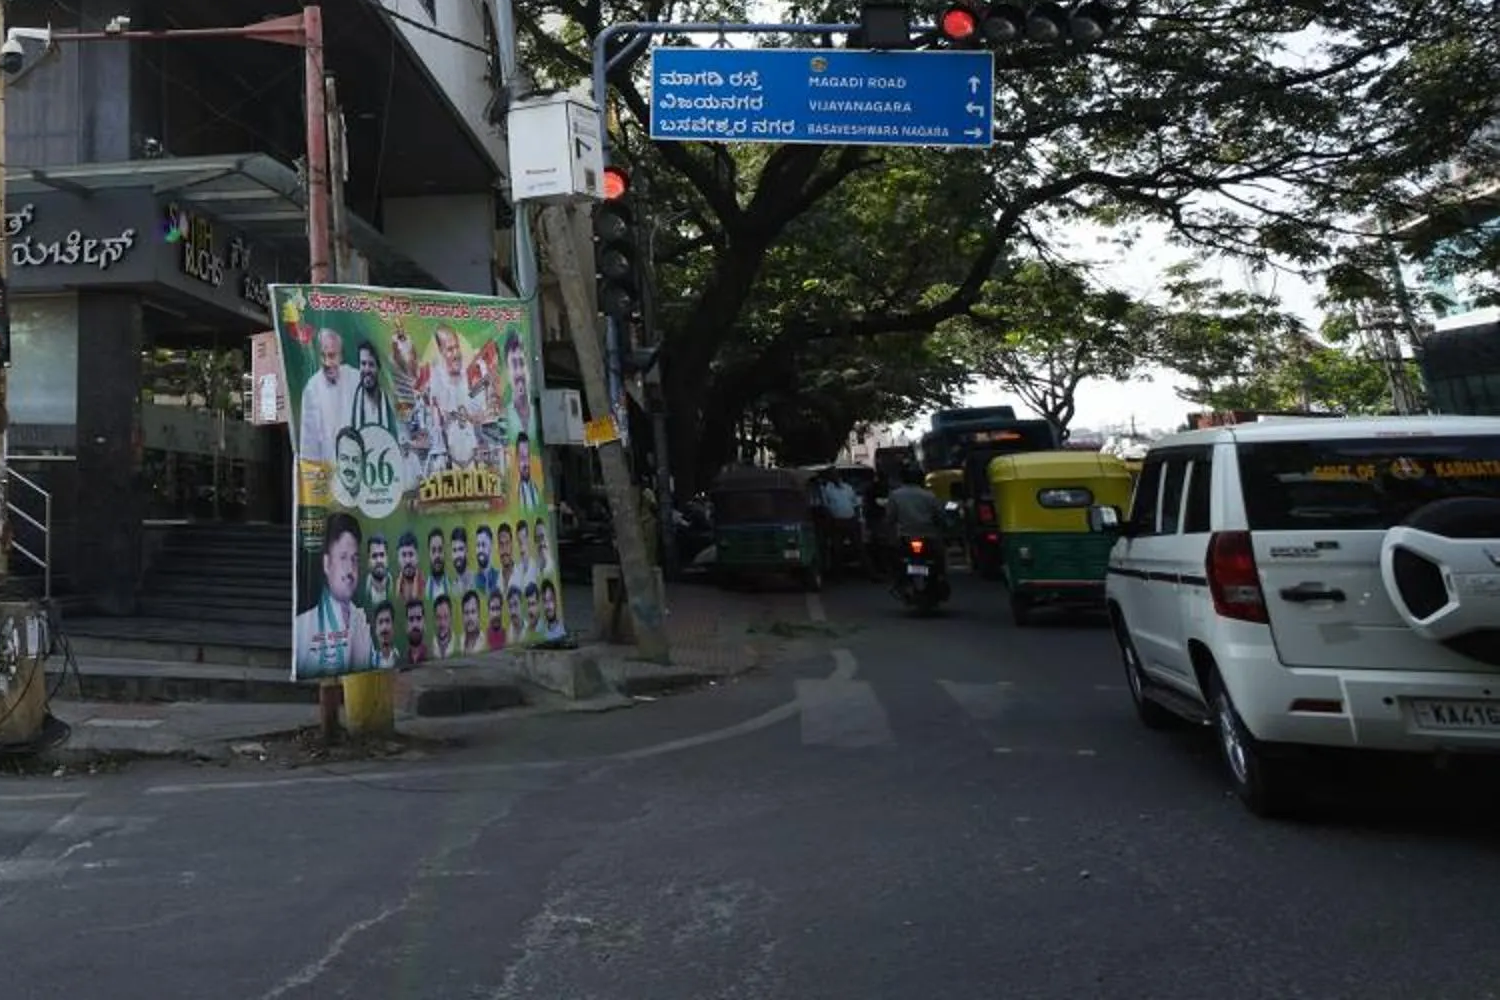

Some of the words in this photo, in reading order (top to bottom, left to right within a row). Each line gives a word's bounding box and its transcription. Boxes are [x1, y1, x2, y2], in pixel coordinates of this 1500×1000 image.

[659, 70, 724, 86] ಮಾಗಡಿ
[729, 70, 763, 91] ರಸ್ತೆ
[808, 76, 863, 88] MAGADI
[867, 77, 907, 89] ROAD
[659, 92, 764, 110] ವಿಜಯನಗರ
[808, 100, 912, 113] VIJAYANAGARA
[660, 116, 747, 136] ಬಸವೇಶ್ವರ
[751, 119, 795, 134] ನಗರ
[807, 123, 899, 136] BASAVESHWARA
[901, 126, 949, 137] NAGARA
